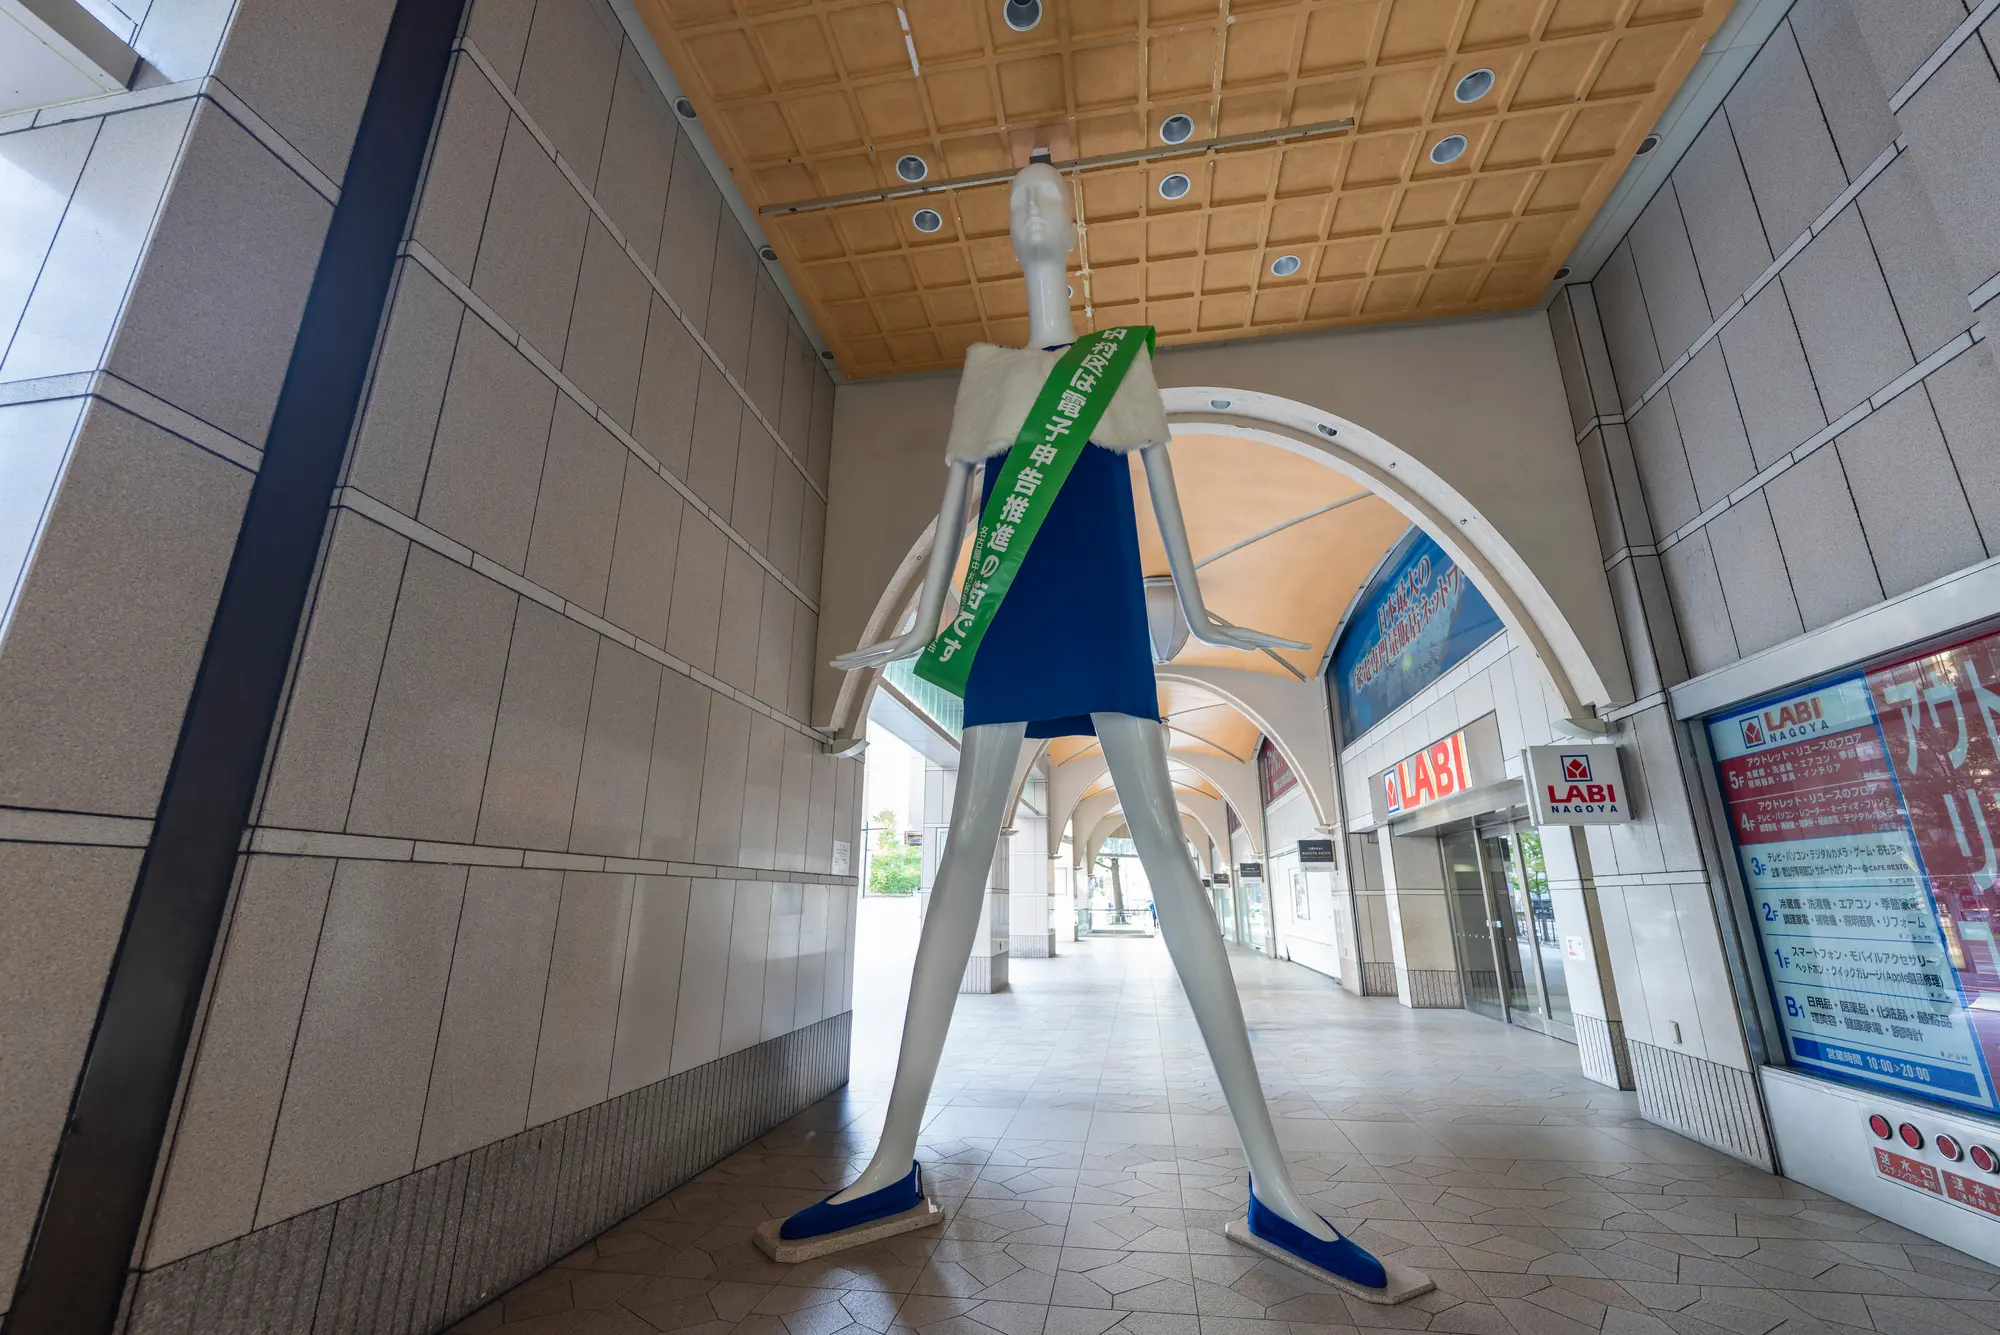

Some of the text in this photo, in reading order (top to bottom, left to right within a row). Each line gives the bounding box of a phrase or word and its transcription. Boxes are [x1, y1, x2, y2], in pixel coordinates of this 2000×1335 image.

[1377, 556, 1431, 635] 日本最大の
[1354, 564, 1465, 692] 家電専門量販店ネットワ
[1764, 696, 1824, 732] LABI
[1770, 721, 1830, 743] NAGOYA
[1745, 731, 1863, 768] アウトレット・リユースのフロア
[1398, 731, 1473, 810] LABI
[1728, 769, 1745, 789] 5F
[1547, 784, 1617, 803] LABI
[1757, 782, 1878, 811] アウトレット・リユースのフロア
[1551, 804, 1619, 813] NAGOYA
[1739, 812, 1756, 831] 4F
[1750, 856, 1768, 875] 3F
[1869, 864, 1886, 872] CAFE
[1886, 863, 1909, 871] RESTO
[1761, 902, 1779, 921] 2F
[1773, 948, 1791, 968] 1F
[1791, 947, 1937, 968] スマートフォン・モバイルアクセサリー
[1784, 995, 1805, 1018] B1
[1826, 1048, 1863, 1065] 営業時間
